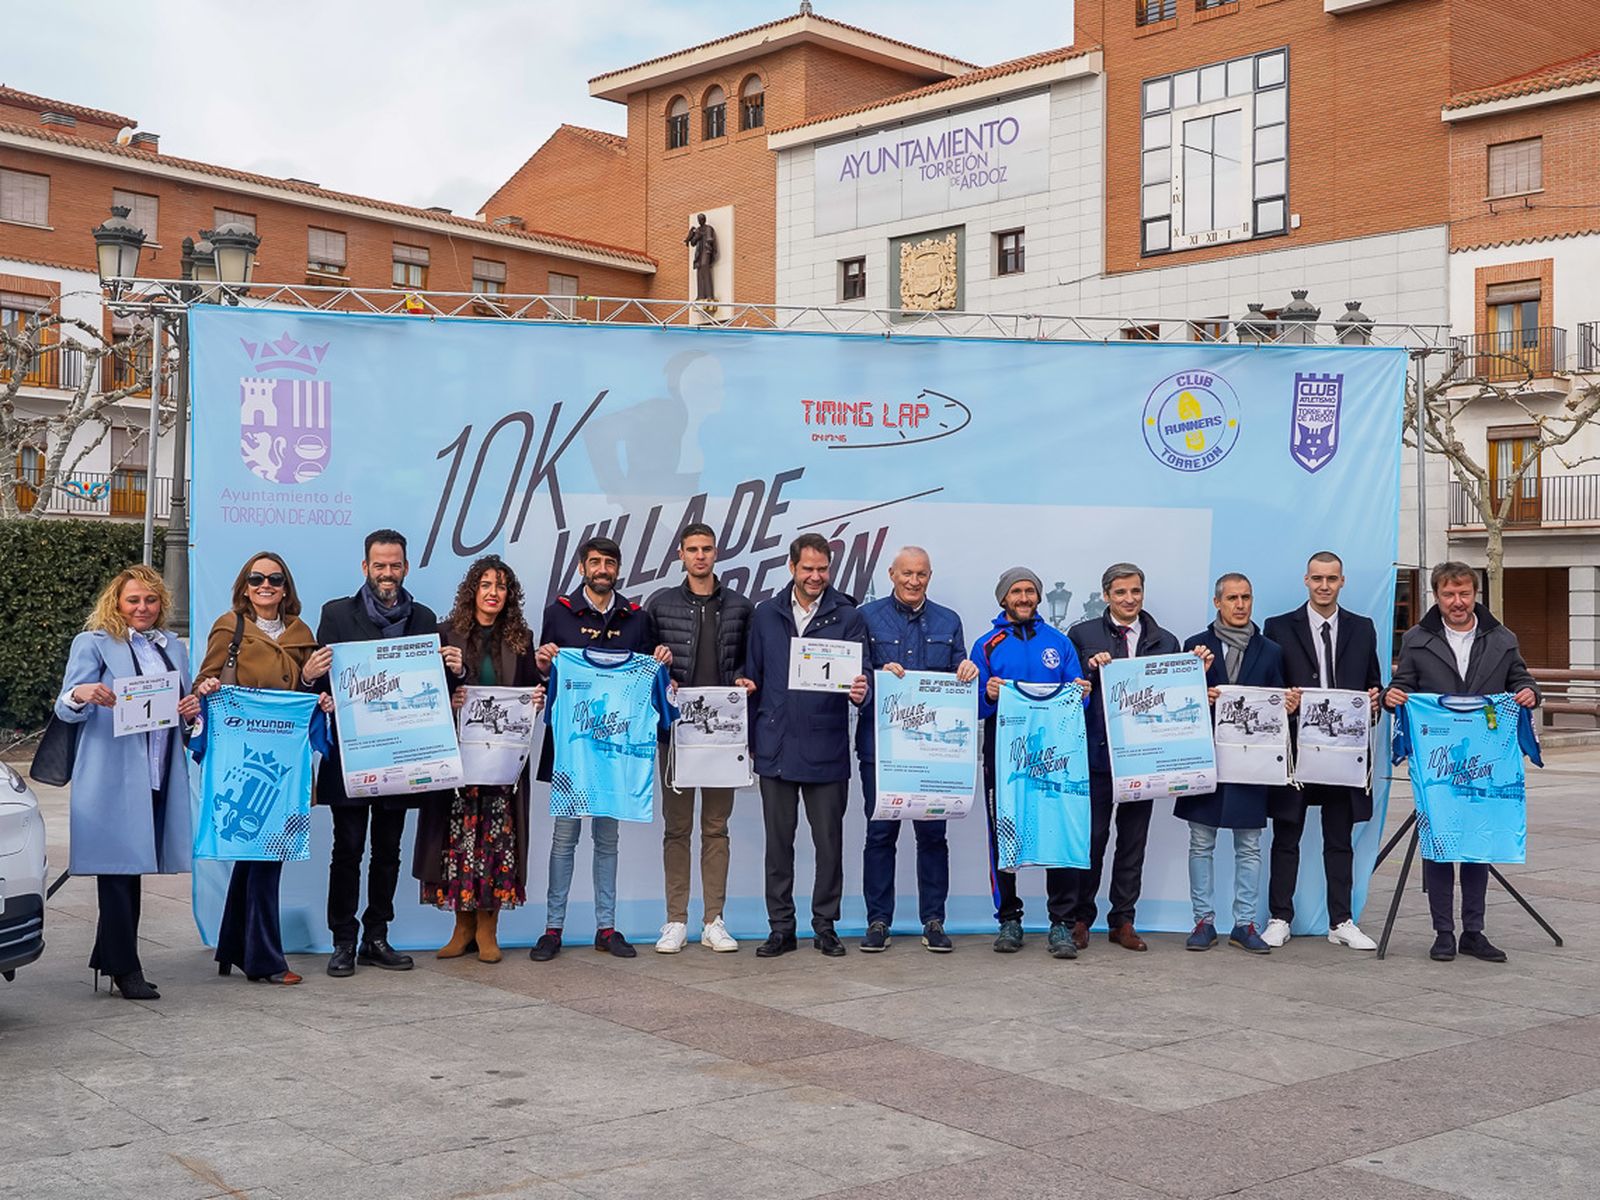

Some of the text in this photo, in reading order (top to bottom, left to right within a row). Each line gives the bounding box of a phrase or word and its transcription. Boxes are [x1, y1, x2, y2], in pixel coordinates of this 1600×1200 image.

[840, 117, 1020, 182] AYUNTAMIENTO
[919, 152, 989, 182] TORREJÓN
[950, 166, 1008, 191] DE ARDOZ
[1176, 375, 1214, 388] CLUB
[1300, 383, 1337, 396] CLUB
[1299, 396, 1336, 404] ATLETISMO
[801, 400, 930, 429] TIMING LAP
[1164, 415, 1223, 436] RUNNERS
[1160, 446, 1224, 469] TORREJON
[419, 389, 609, 568] 10K
[221, 488, 352, 504] Ayuntamiento de
[221, 505, 352, 527] TORREJÓN DE ARDOZ
[543, 467, 805, 606] VLA DE
[822, 662, 830, 680] 1
[143, 699, 151, 719] 1
[247, 719, 295, 729] HYUNDAI
